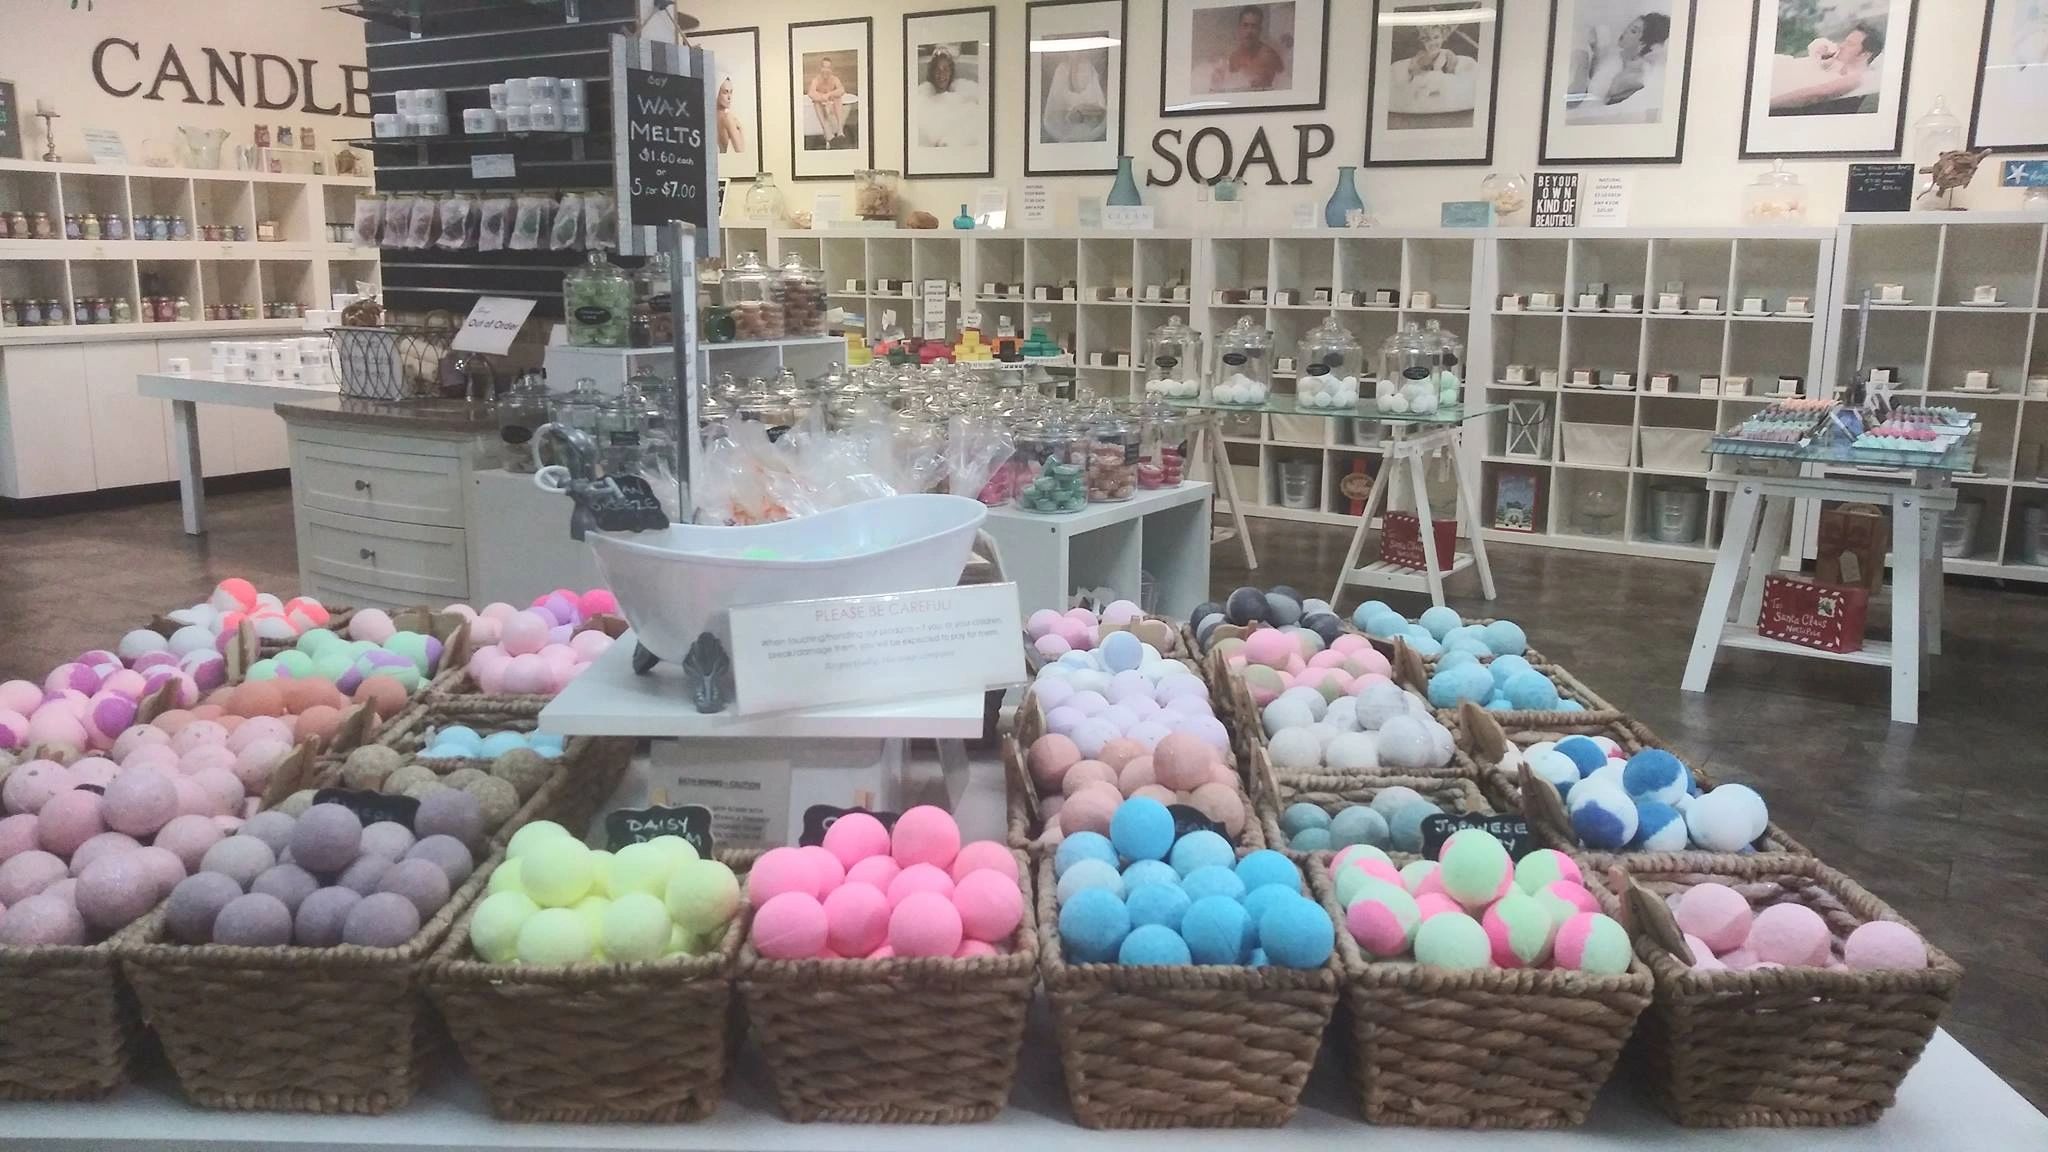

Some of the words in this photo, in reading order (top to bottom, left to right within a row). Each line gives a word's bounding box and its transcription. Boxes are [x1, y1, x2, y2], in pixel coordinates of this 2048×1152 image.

[637, 94, 690, 117] WAX
[630, 120, 701, 148] MELTS
[639, 147, 675, 164] $1.60
[1146, 123, 1334, 187] SOAP
[631, 177, 642, 195] 5
[661, 181, 696, 199] $7.00
[1538, 175, 1550, 187] BE
[1552, 175, 1577, 187] YOUR
[1542, 188, 1571, 199] OWN
[1536, 199, 1560, 213] KIND
[1563, 199, 1575, 213] OF
[1535, 214, 1574, 227] BEAUTIFUL
[468, 318, 484, 328] Out
[485, 319, 495, 328] of
[494, 320, 519, 331] Order
[816, 606, 865, 622] PLEASE
[868, 604, 885, 617] BE
[1773, 611, 1800, 625] Santa
[1801, 614, 1828, 628] Claus
[626, 816, 689, 833] DAISY
